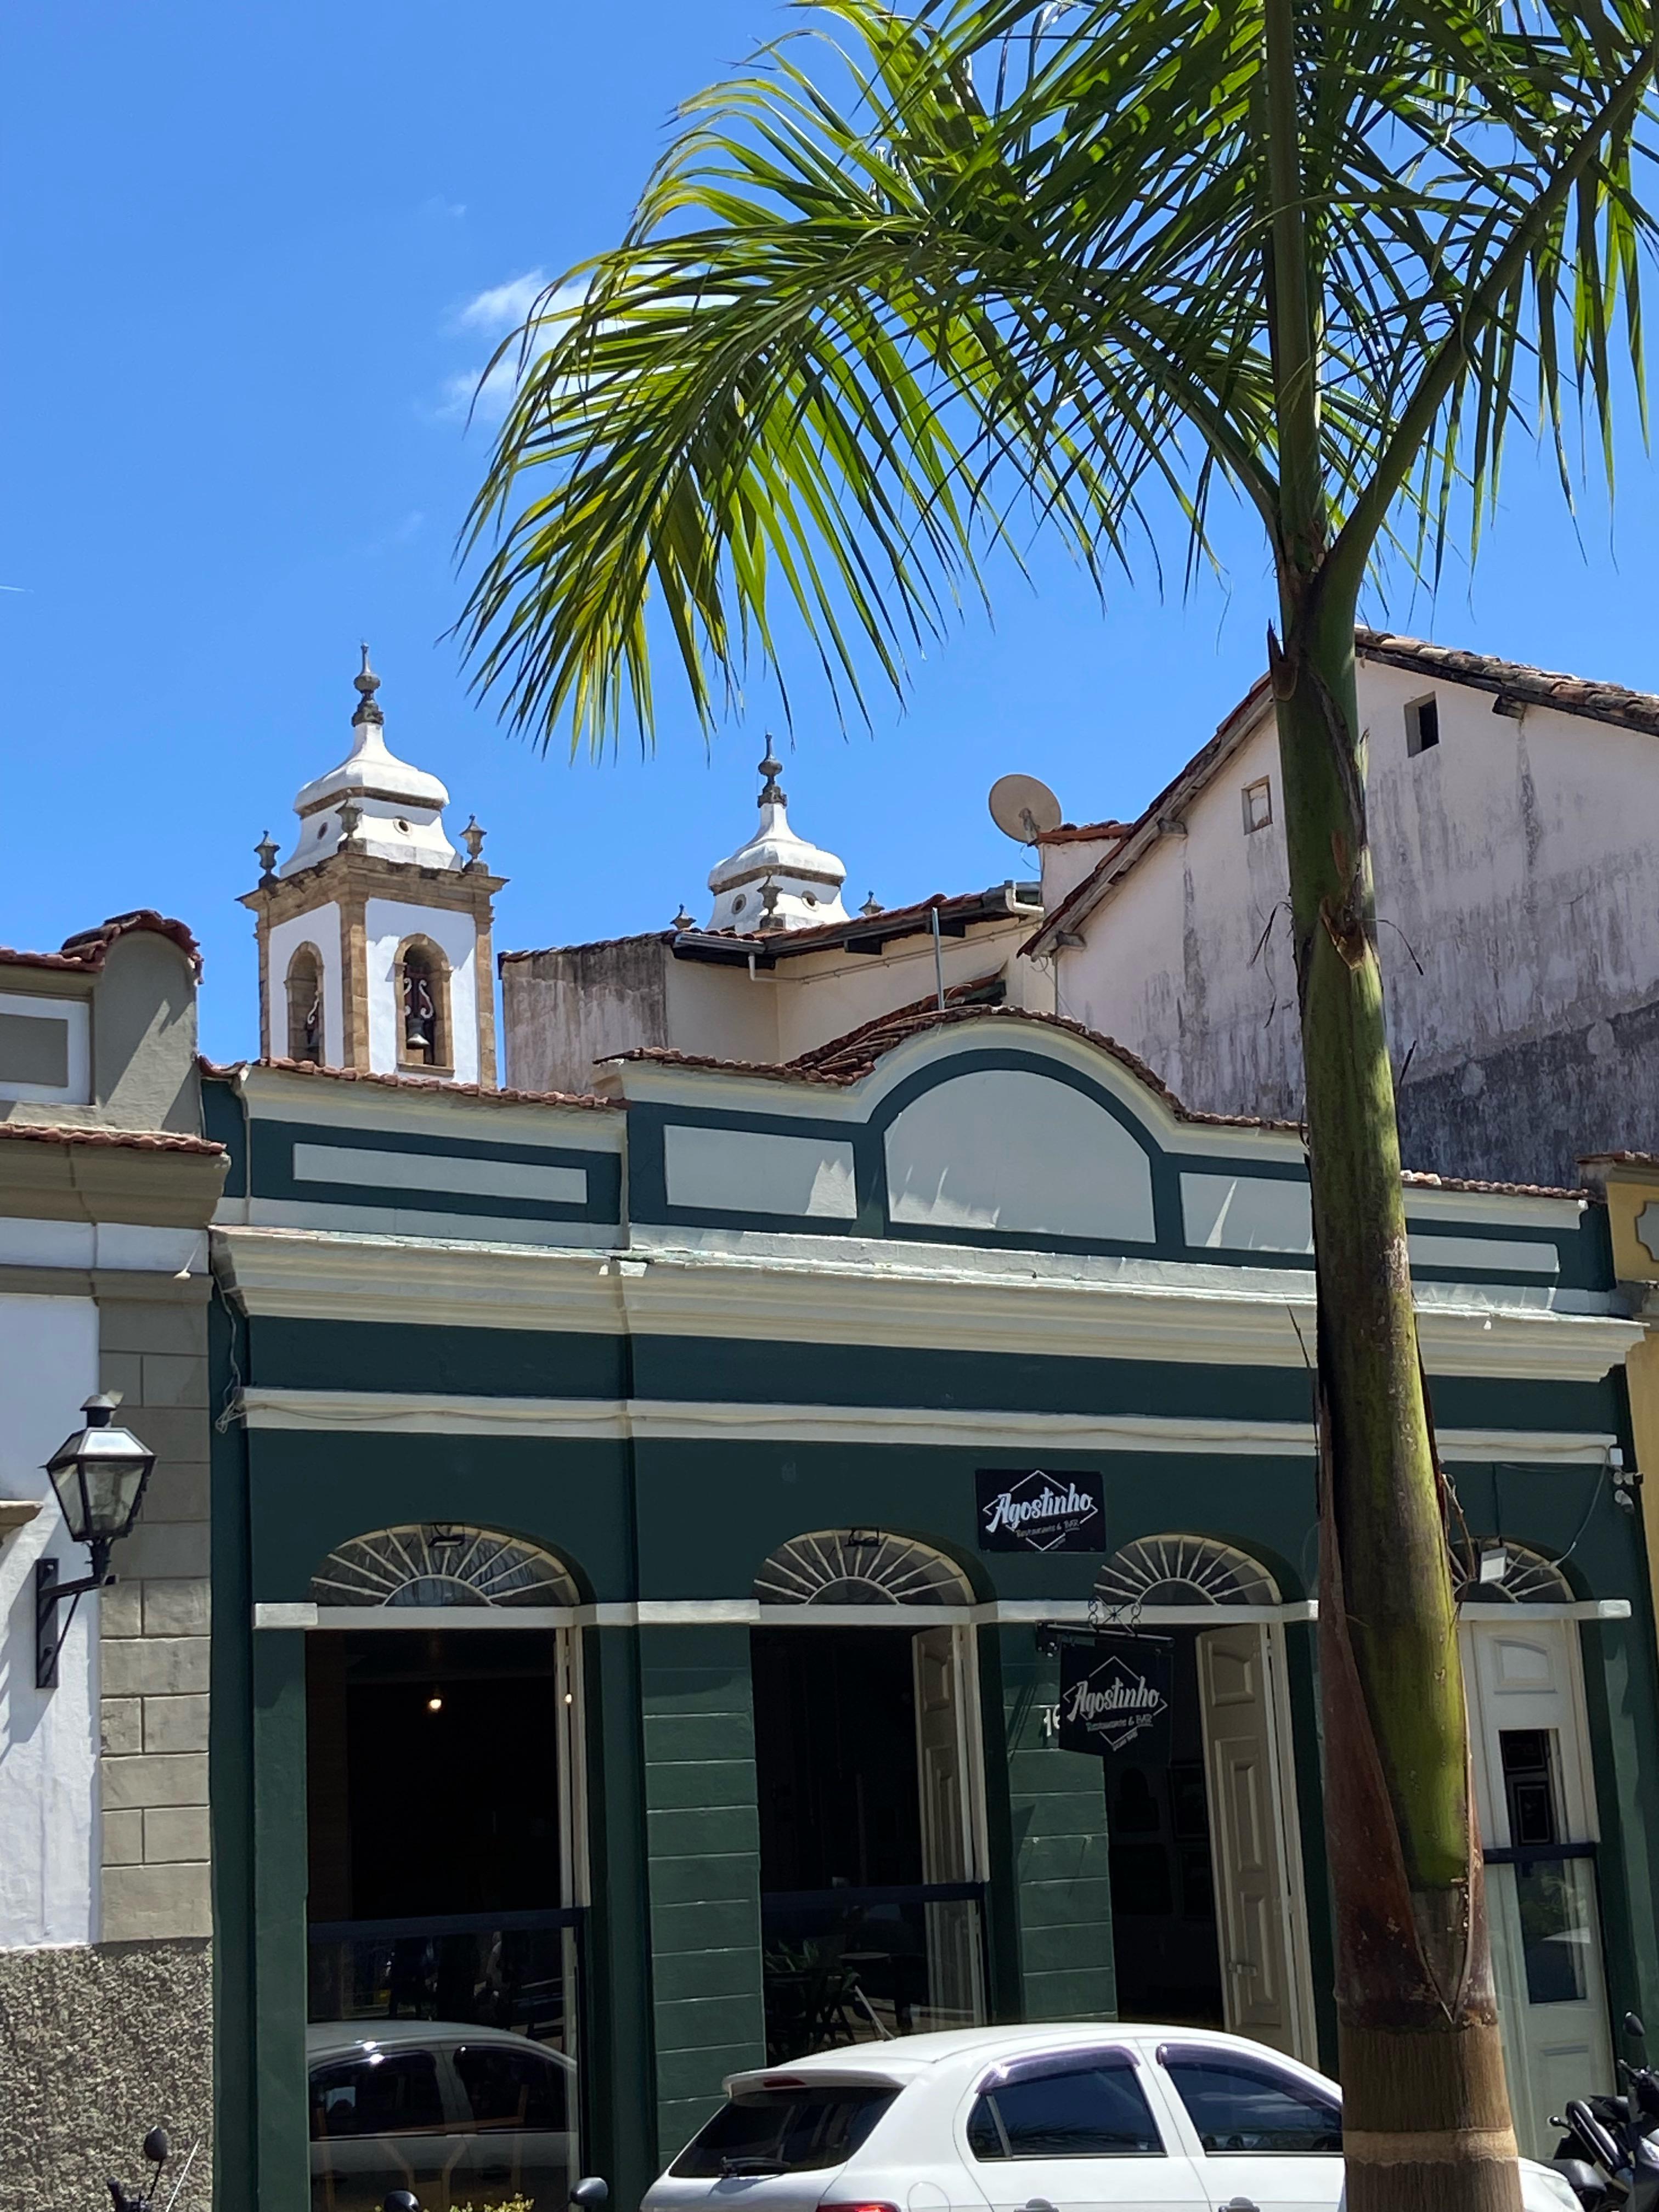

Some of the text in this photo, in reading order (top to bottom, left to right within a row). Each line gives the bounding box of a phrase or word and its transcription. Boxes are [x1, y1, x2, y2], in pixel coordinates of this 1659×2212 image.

[985, 1482, 1093, 1533] Agostinho
[1066, 1675, 1160, 1722] Agostinho
[1136, 1713, 1153, 1725] BAR
